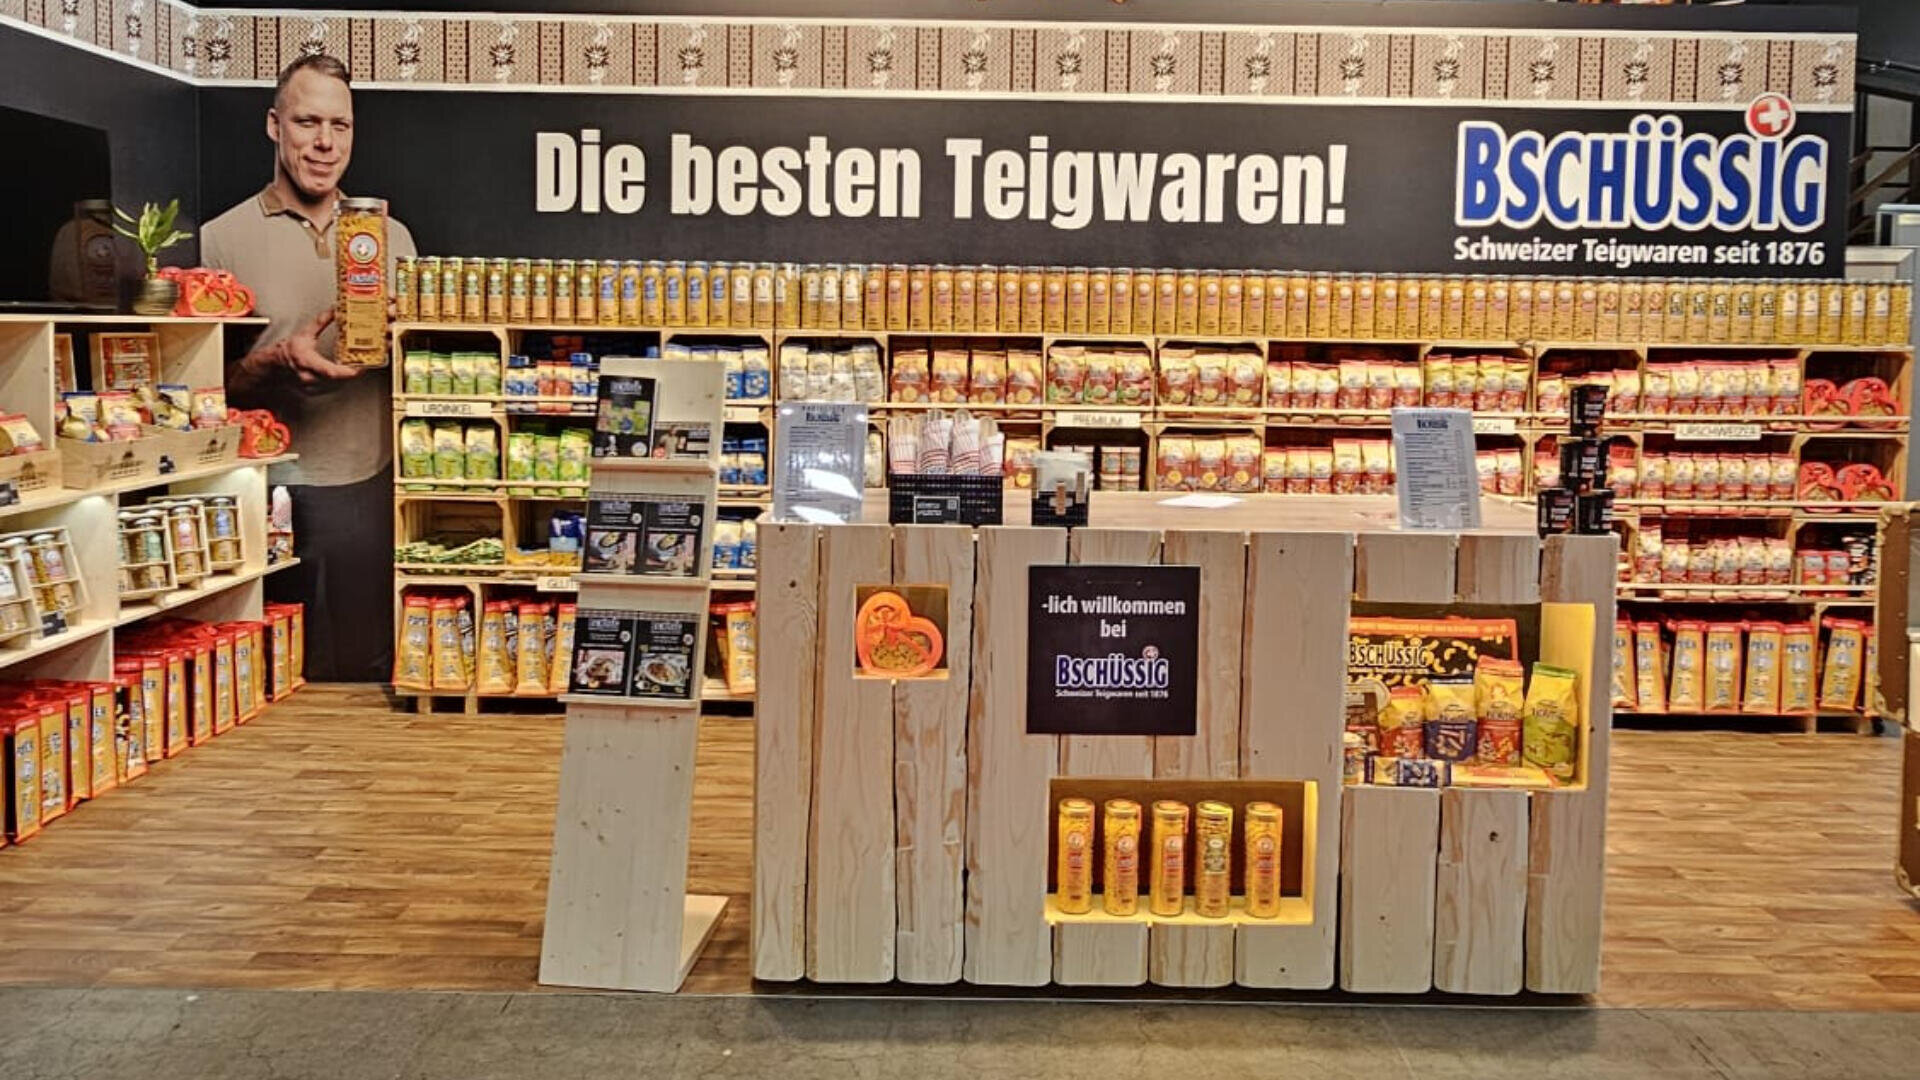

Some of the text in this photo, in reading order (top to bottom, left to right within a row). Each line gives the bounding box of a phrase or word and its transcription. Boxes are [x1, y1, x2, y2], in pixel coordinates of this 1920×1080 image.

[536, 129, 1348, 230] Die besten Teigwaren!
[1456, 93, 1829, 232] BSCHÜSSIG
[1454, 237, 1825, 268] Schweizer Teigwaren seit 1876
[1042, 595, 1186, 614] -lich willkommen
[1100, 619, 1127, 637] bei
[1056, 646, 1169, 688] BSCHÜSSIG
